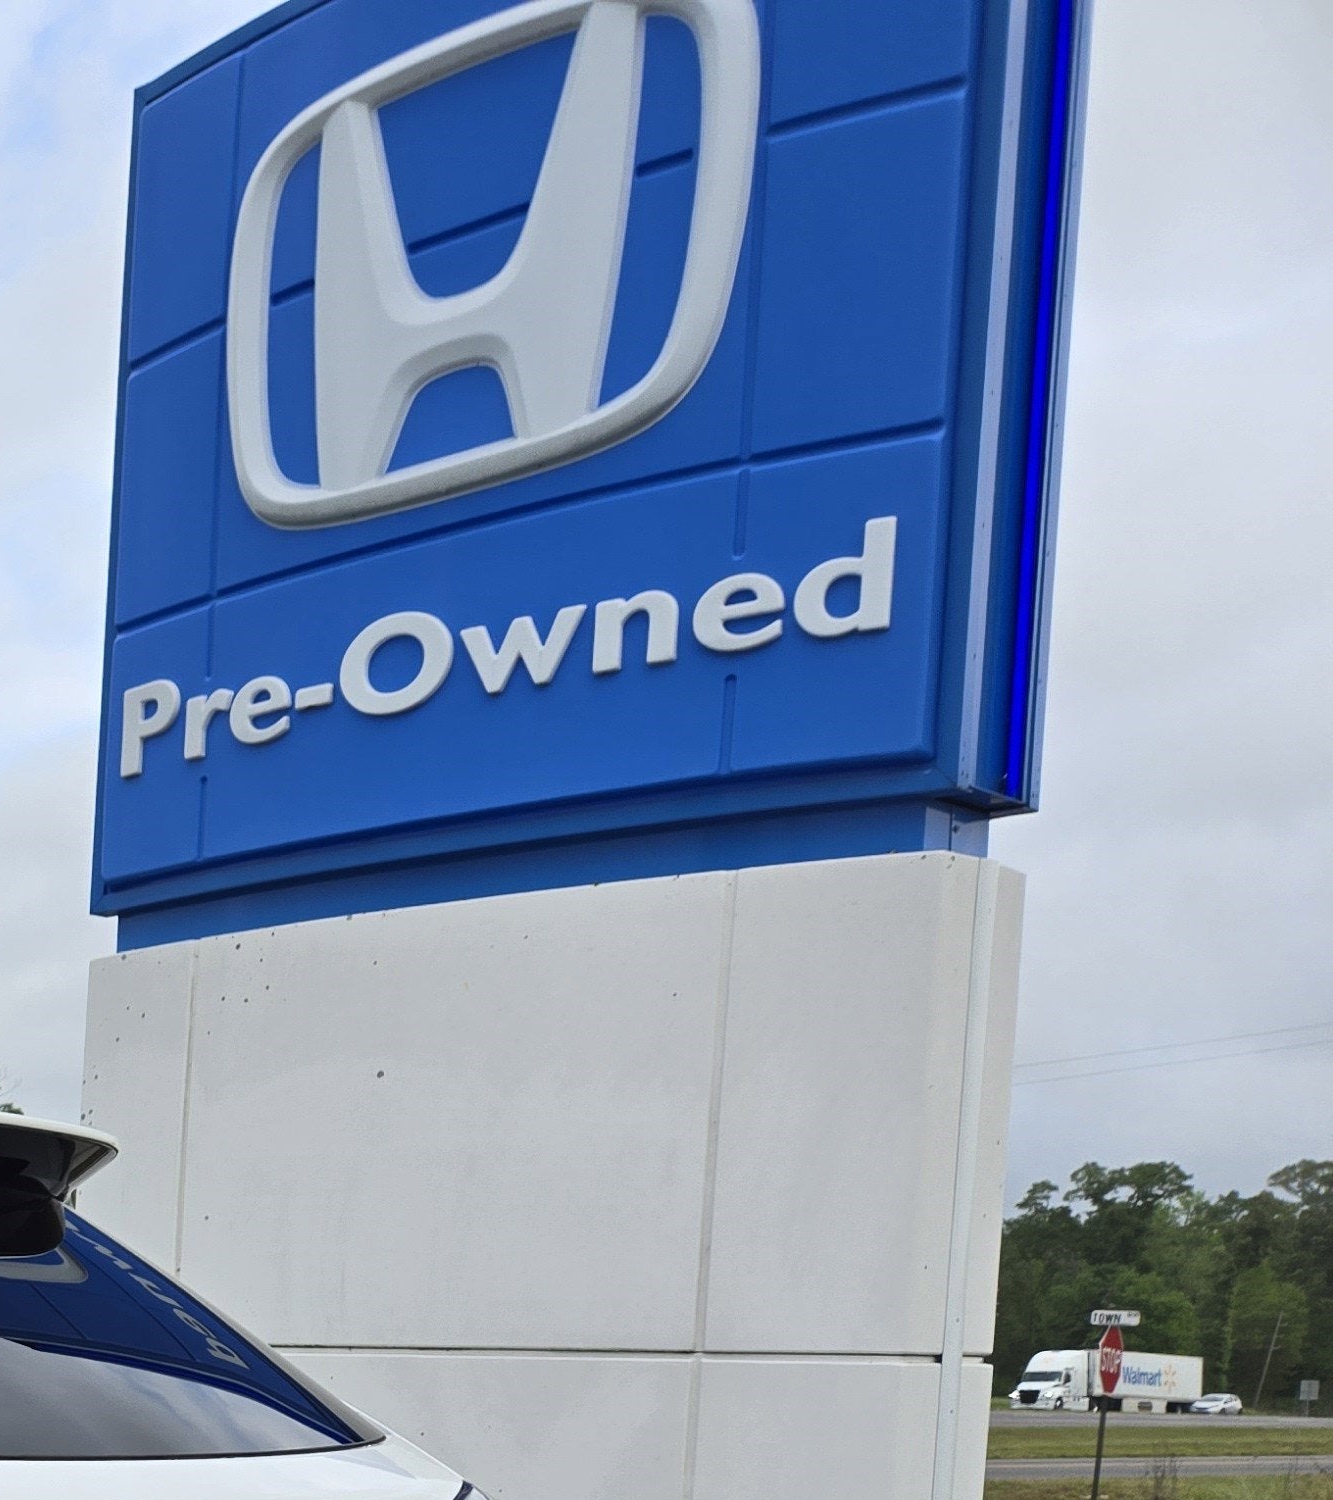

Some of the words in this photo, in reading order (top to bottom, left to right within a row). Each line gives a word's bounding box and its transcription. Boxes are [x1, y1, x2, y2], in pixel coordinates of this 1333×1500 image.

[120, 516, 897, 778] Pre-Owned
[1101, 1347, 1121, 1373] STOP
[1122, 1366, 1162, 1387] Walmart
